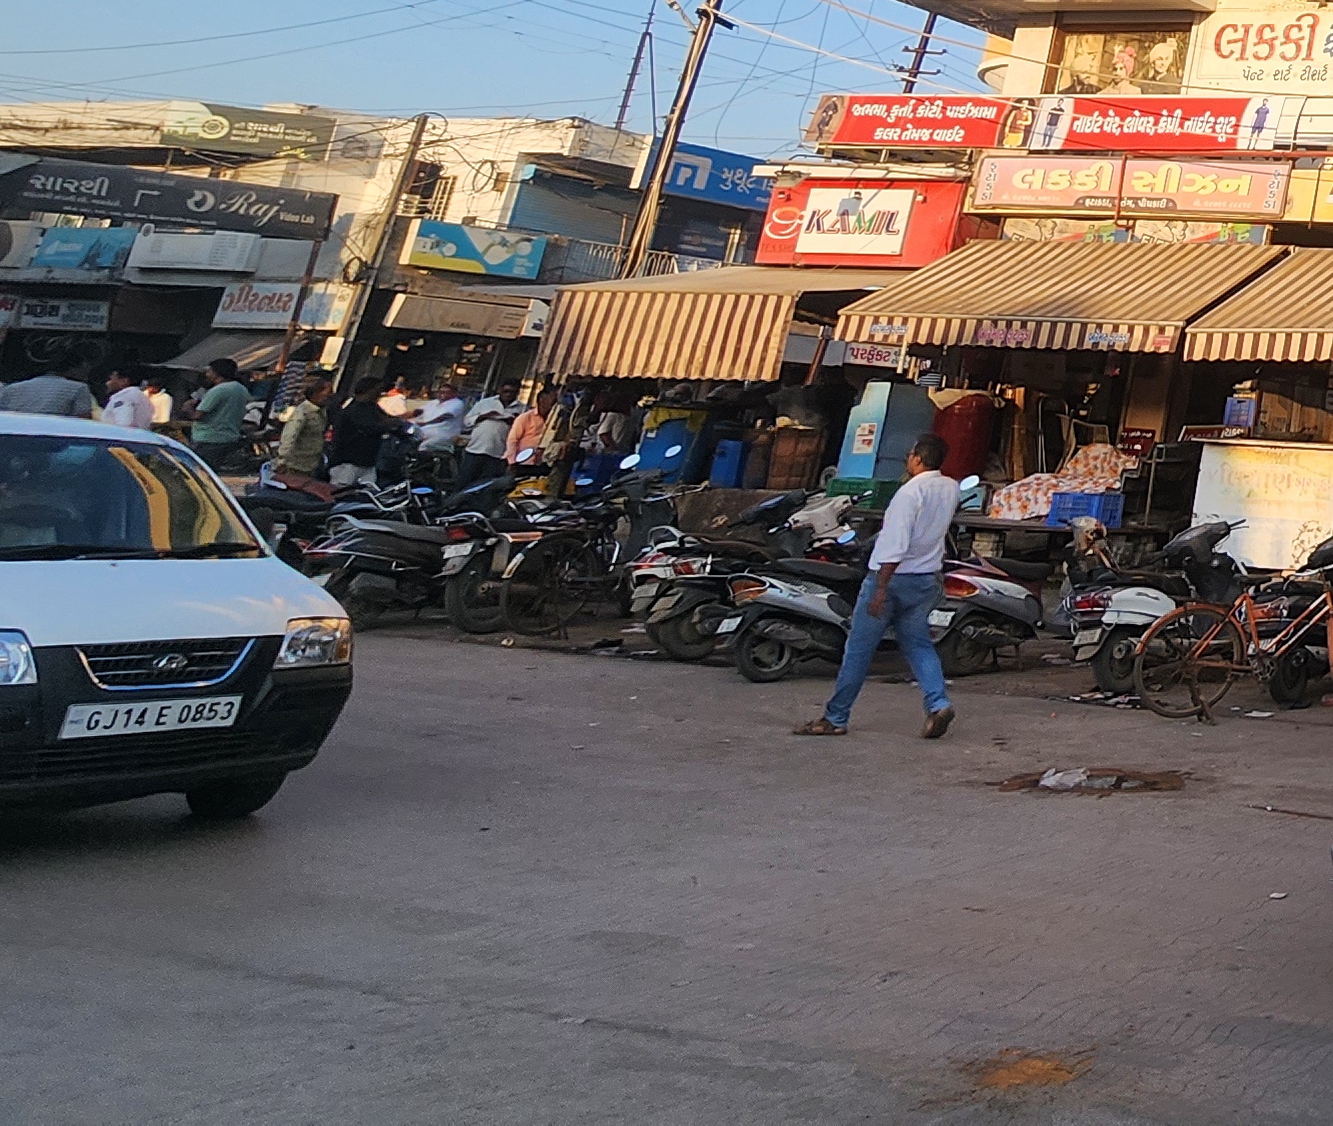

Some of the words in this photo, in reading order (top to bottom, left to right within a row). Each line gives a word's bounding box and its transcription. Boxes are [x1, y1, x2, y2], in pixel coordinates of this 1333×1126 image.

[1242, 66, 1264, 81] પેન્ટ
[1273, 64, 1293, 81] શર્ટ
[1300, 64, 1329, 82] ટીશર્ટ
[873, 127, 900, 142] કલર
[901, 123, 931, 142] તેમજ
[29, 174, 110, 197] સારથી
[1131, 163, 1252, 196] સીઝન
[219, 190, 286, 227] Raj
[805, 208, 900, 236] KAMIL
[86, 708, 148, 732] GJ14
[155, 705, 172, 727] E
[177, 702, 235, 725] 0853
